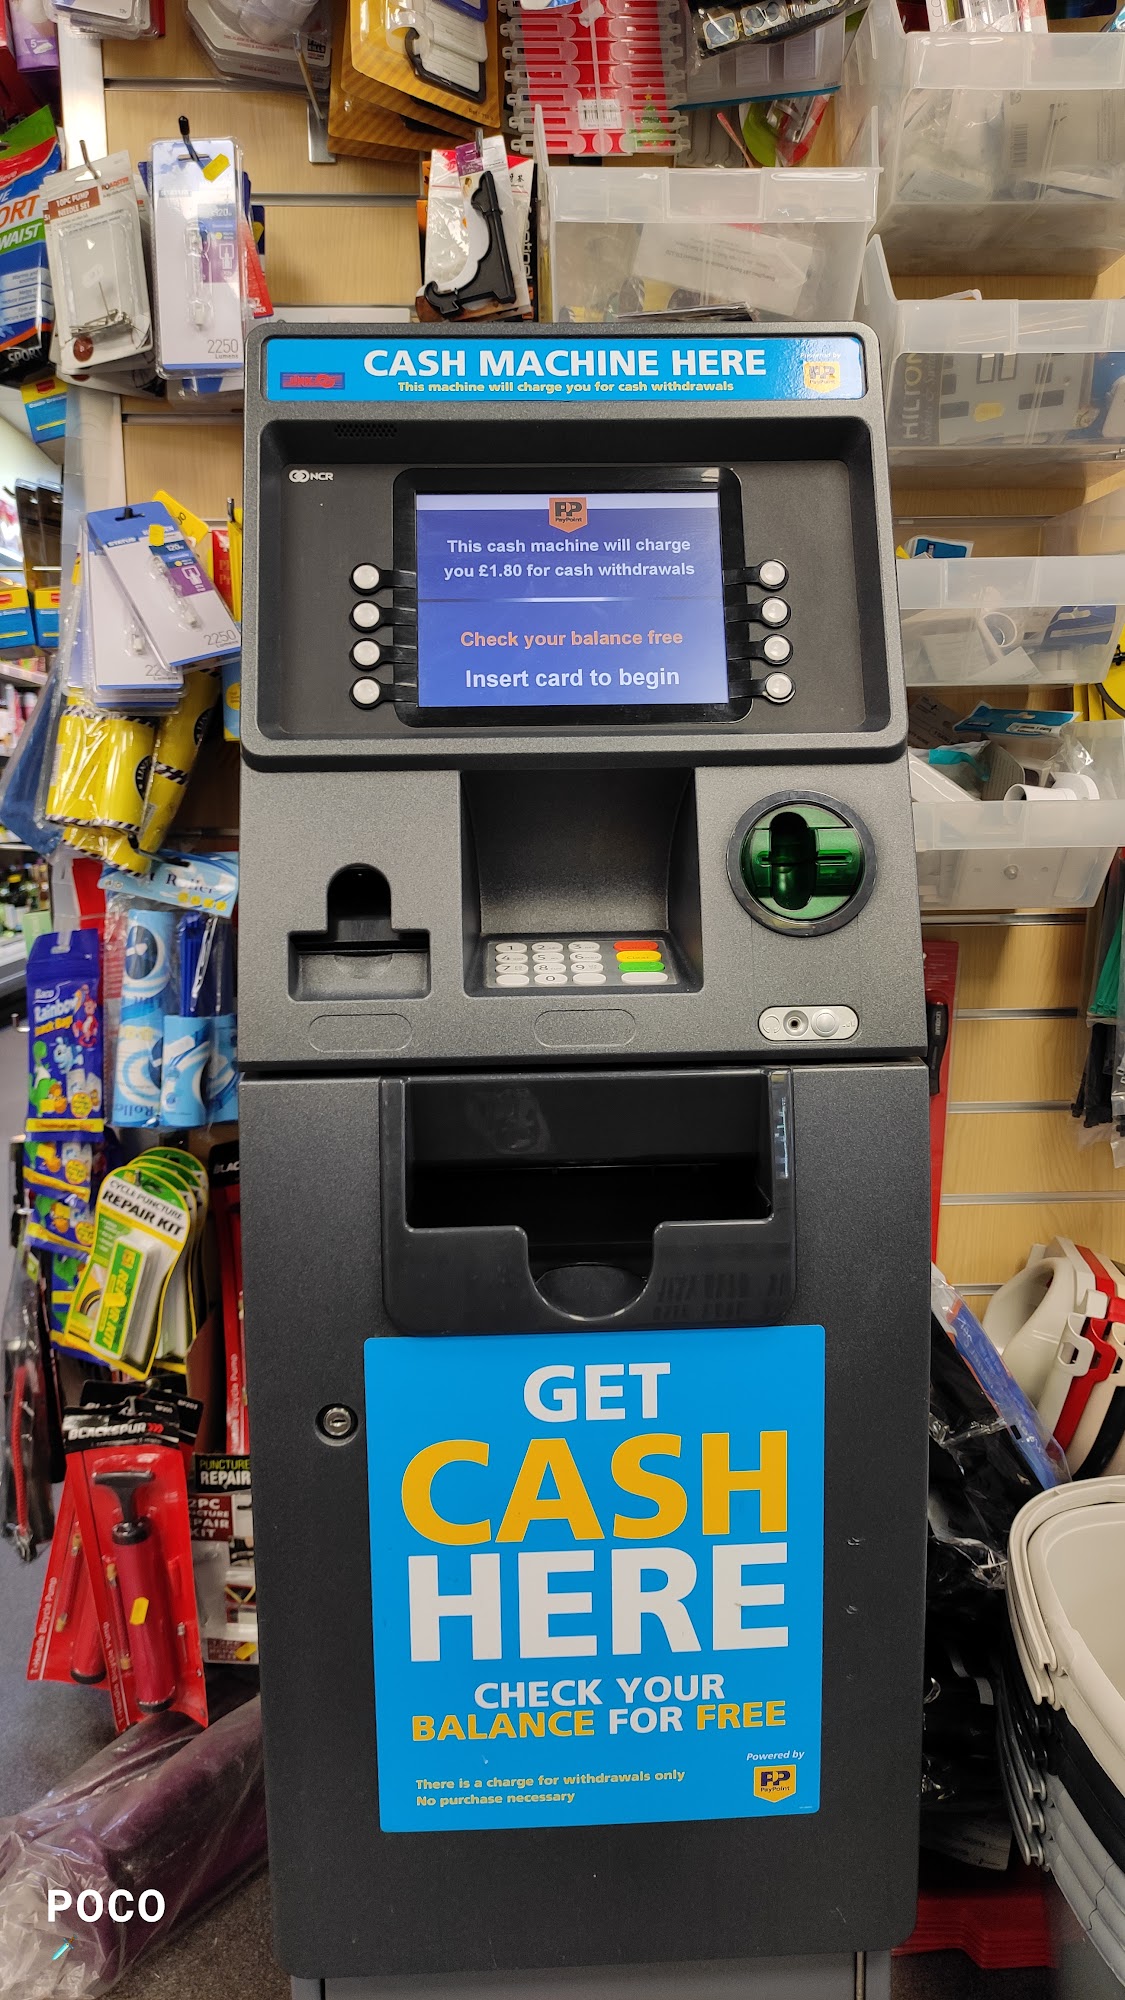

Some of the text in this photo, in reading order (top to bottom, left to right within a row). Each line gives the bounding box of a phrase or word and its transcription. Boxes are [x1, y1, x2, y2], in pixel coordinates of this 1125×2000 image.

[80, 201, 90, 211] SET
[208, 339, 238, 353] 2250
[364, 350, 766, 376] CASH MACHINE HERE
[398, 380, 734, 393] This machine will charge you for cash withdrawals
[310, 472, 333, 480] NCR
[447, 539, 690, 554] This cash machine will charge
[444, 563, 695, 581] you £1.80 for cash withdrawals
[204, 630, 236, 645] 2250
[460, 630, 683, 649] Check your balance free
[465, 668, 680, 690] Insert card to begin
[110, 1180, 183, 1219] CYCLE PUNCTURE
[102, 1190, 184, 1235] REPAIR KIT
[523, 1362, 671, 1423] GET
[200, 1459, 250, 1471] PUNCTURE
[201, 1470, 251, 1487] REPAIR
[401, 1430, 788, 1546] CASH
[38, 1603, 51, 1633] Bicycle
[45, 1577, 57, 1602] Pump
[408, 1541, 789, 1662] HERE
[103, 1622, 112, 1649] Pump
[474, 1673, 725, 1709] CHECK YOUR
[411, 1700, 787, 1742] BALANCE FOR FREE
[746, 1750, 805, 1761] Powered by
[416, 1769, 686, 1790] There is a charge for withdrawals only
[416, 1792, 576, 1809] No purchase necessary
